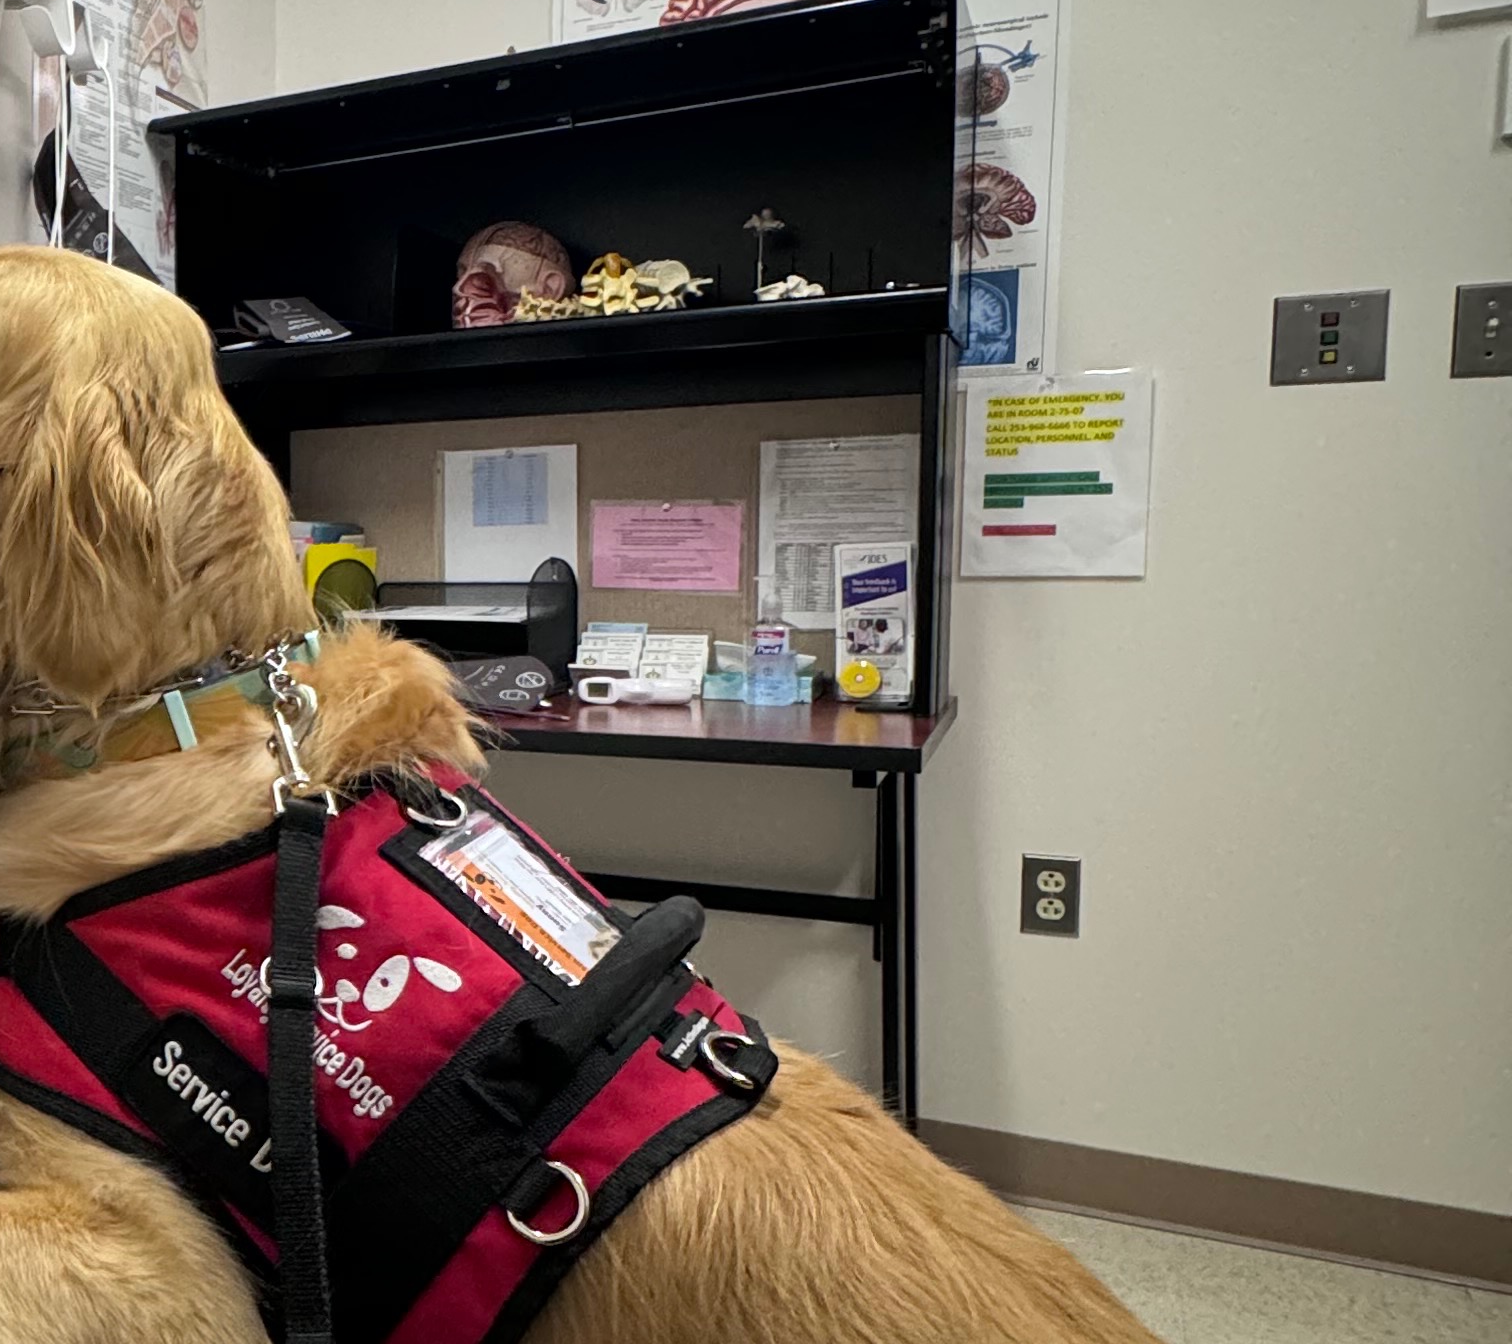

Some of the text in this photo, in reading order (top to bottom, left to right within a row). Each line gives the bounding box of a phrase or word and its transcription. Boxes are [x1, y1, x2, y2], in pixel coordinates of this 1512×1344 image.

[1004, 397, 1026, 406] CASE
[1029, 396, 1041, 405] OF
[1105, 392, 1125, 402] YOU
[987, 410, 1005, 419] ARE
[1006, 410, 1016, 419] IN
[1018, 408, 1048, 417] ROOM
[986, 423, 1007, 432] CALL
[1073, 420, 1086, 429] TO
[1088, 418, 1124, 428] REPORT
[1094, 431, 1115, 441] AND
[985, 447, 1019, 457] STATUS
[152, 1040, 251, 1148] Service
[335, 1056, 393, 1119] Dogs
